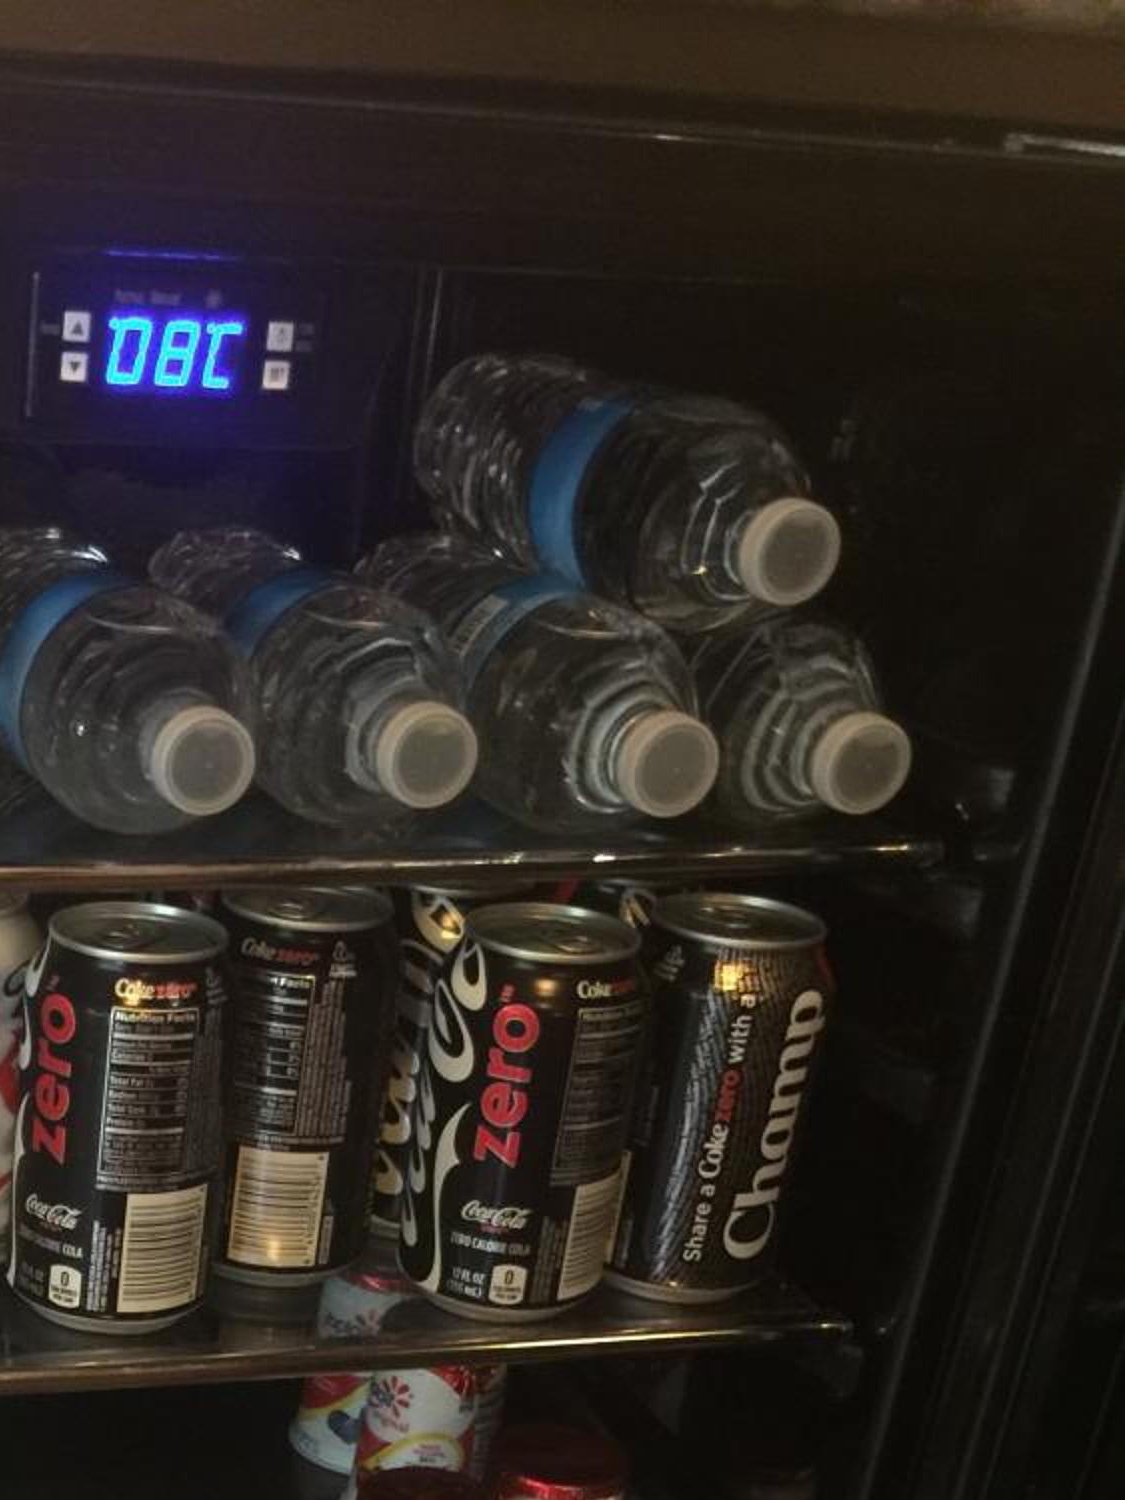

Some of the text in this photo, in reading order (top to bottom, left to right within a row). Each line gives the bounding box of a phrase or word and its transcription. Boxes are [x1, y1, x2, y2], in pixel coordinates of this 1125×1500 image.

[32, 993, 76, 1165] zero
[473, 1003, 541, 1170] zero
[682, 993, 757, 1262] Share a Coke zero with a
[722, 989, 826, 1260] Champ
